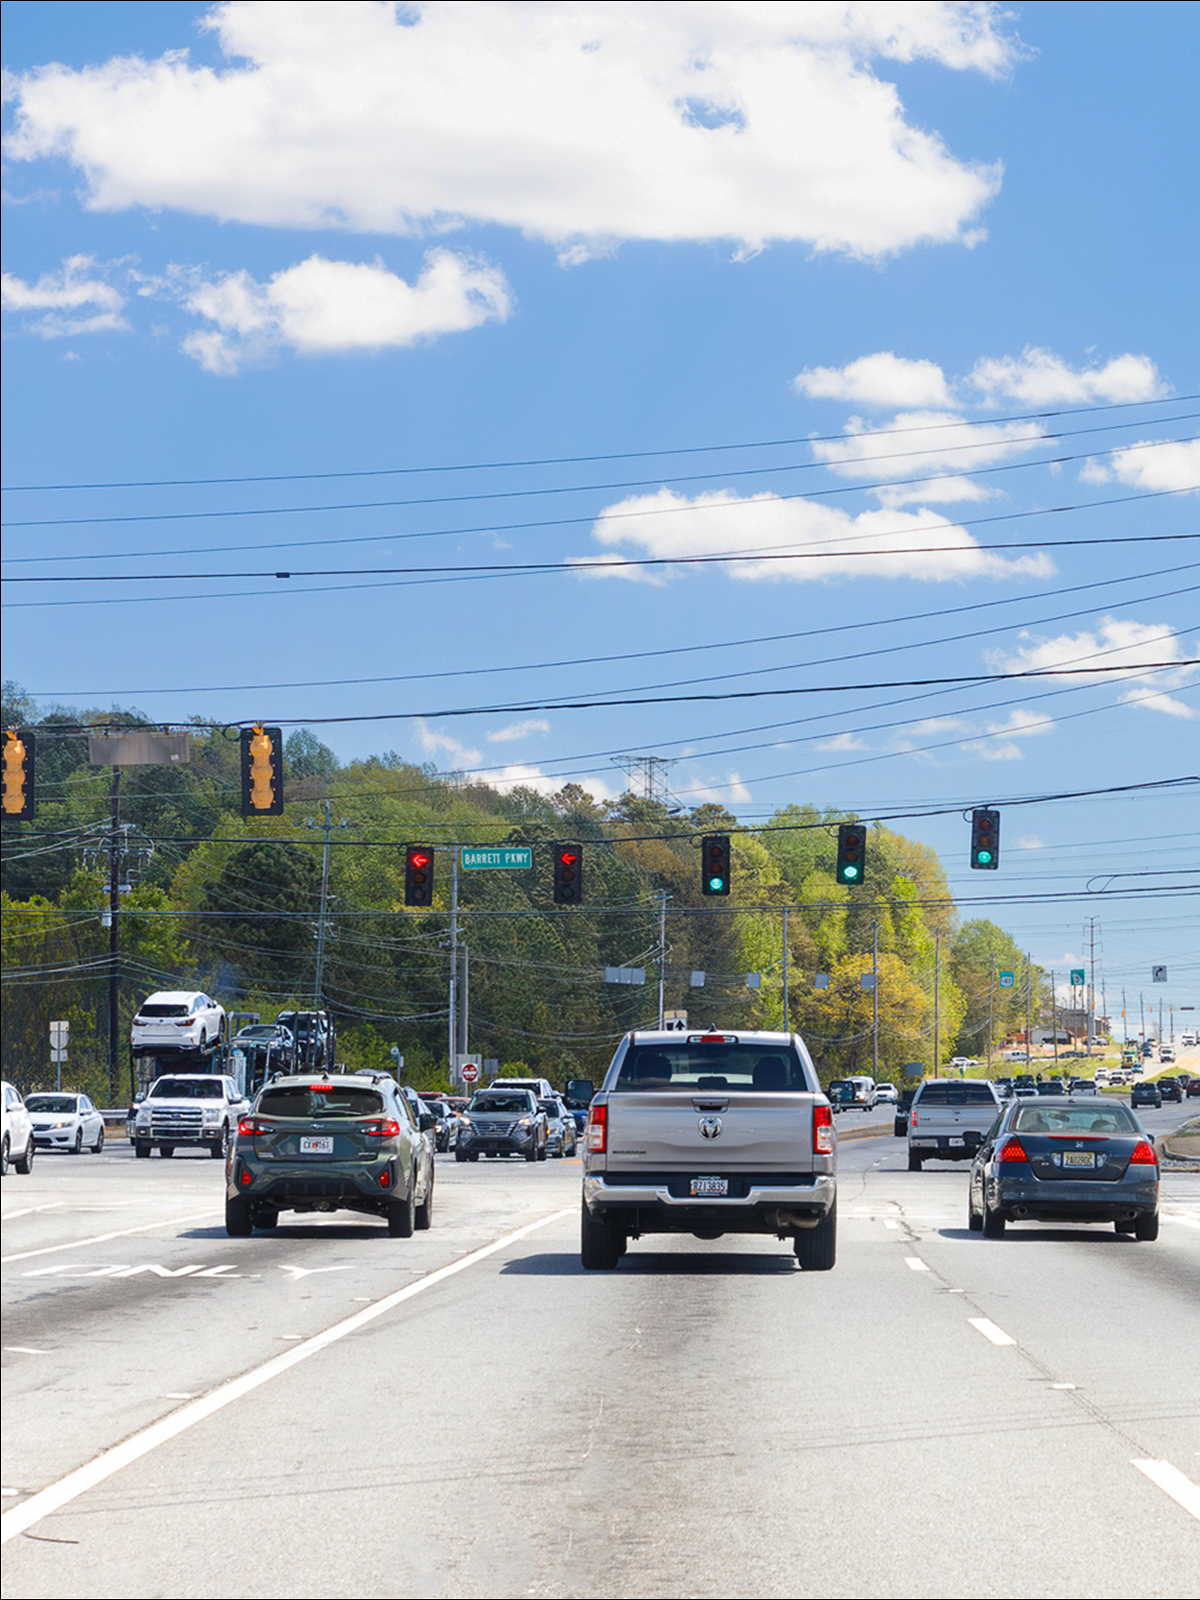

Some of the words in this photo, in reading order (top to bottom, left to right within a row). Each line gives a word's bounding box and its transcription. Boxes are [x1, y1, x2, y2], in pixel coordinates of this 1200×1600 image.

[464, 853, 500, 865] BARRETT
[505, 853, 528, 863] PKWY
[20, 1263, 356, 1281] ONLY
